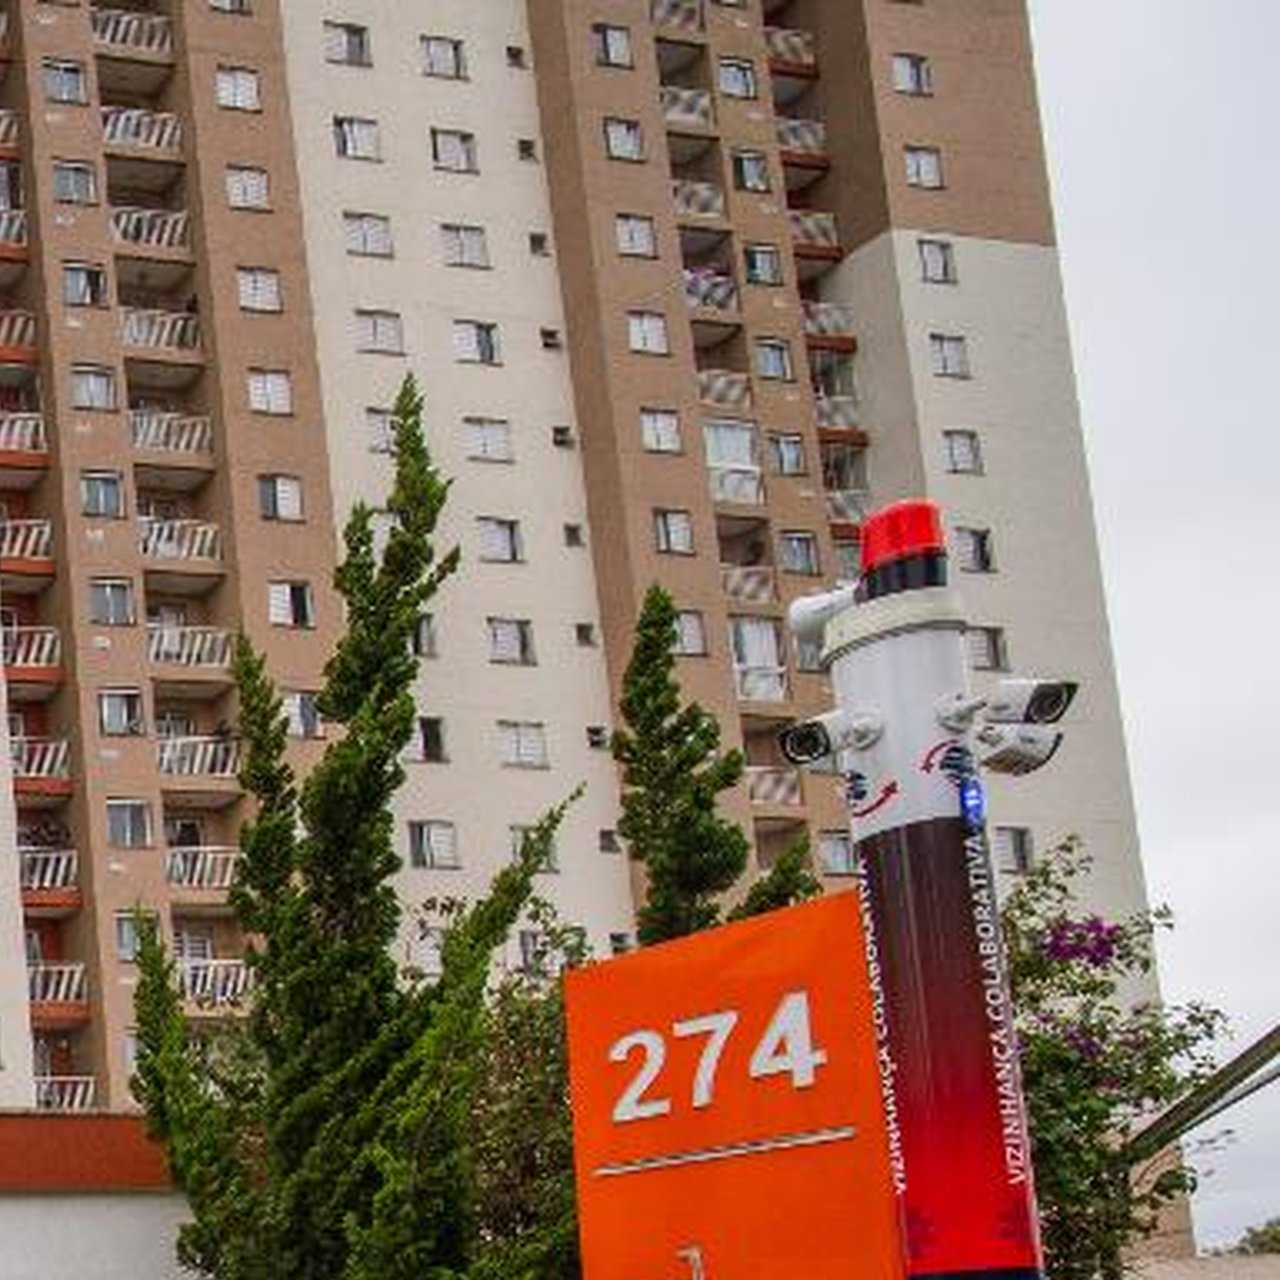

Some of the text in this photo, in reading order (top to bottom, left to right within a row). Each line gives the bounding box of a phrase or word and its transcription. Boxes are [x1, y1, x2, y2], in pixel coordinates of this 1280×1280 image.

[607, 991, 828, 1124] 274
[963, 834, 1028, 1185] VIZINHANÇA COLABORATIVA
